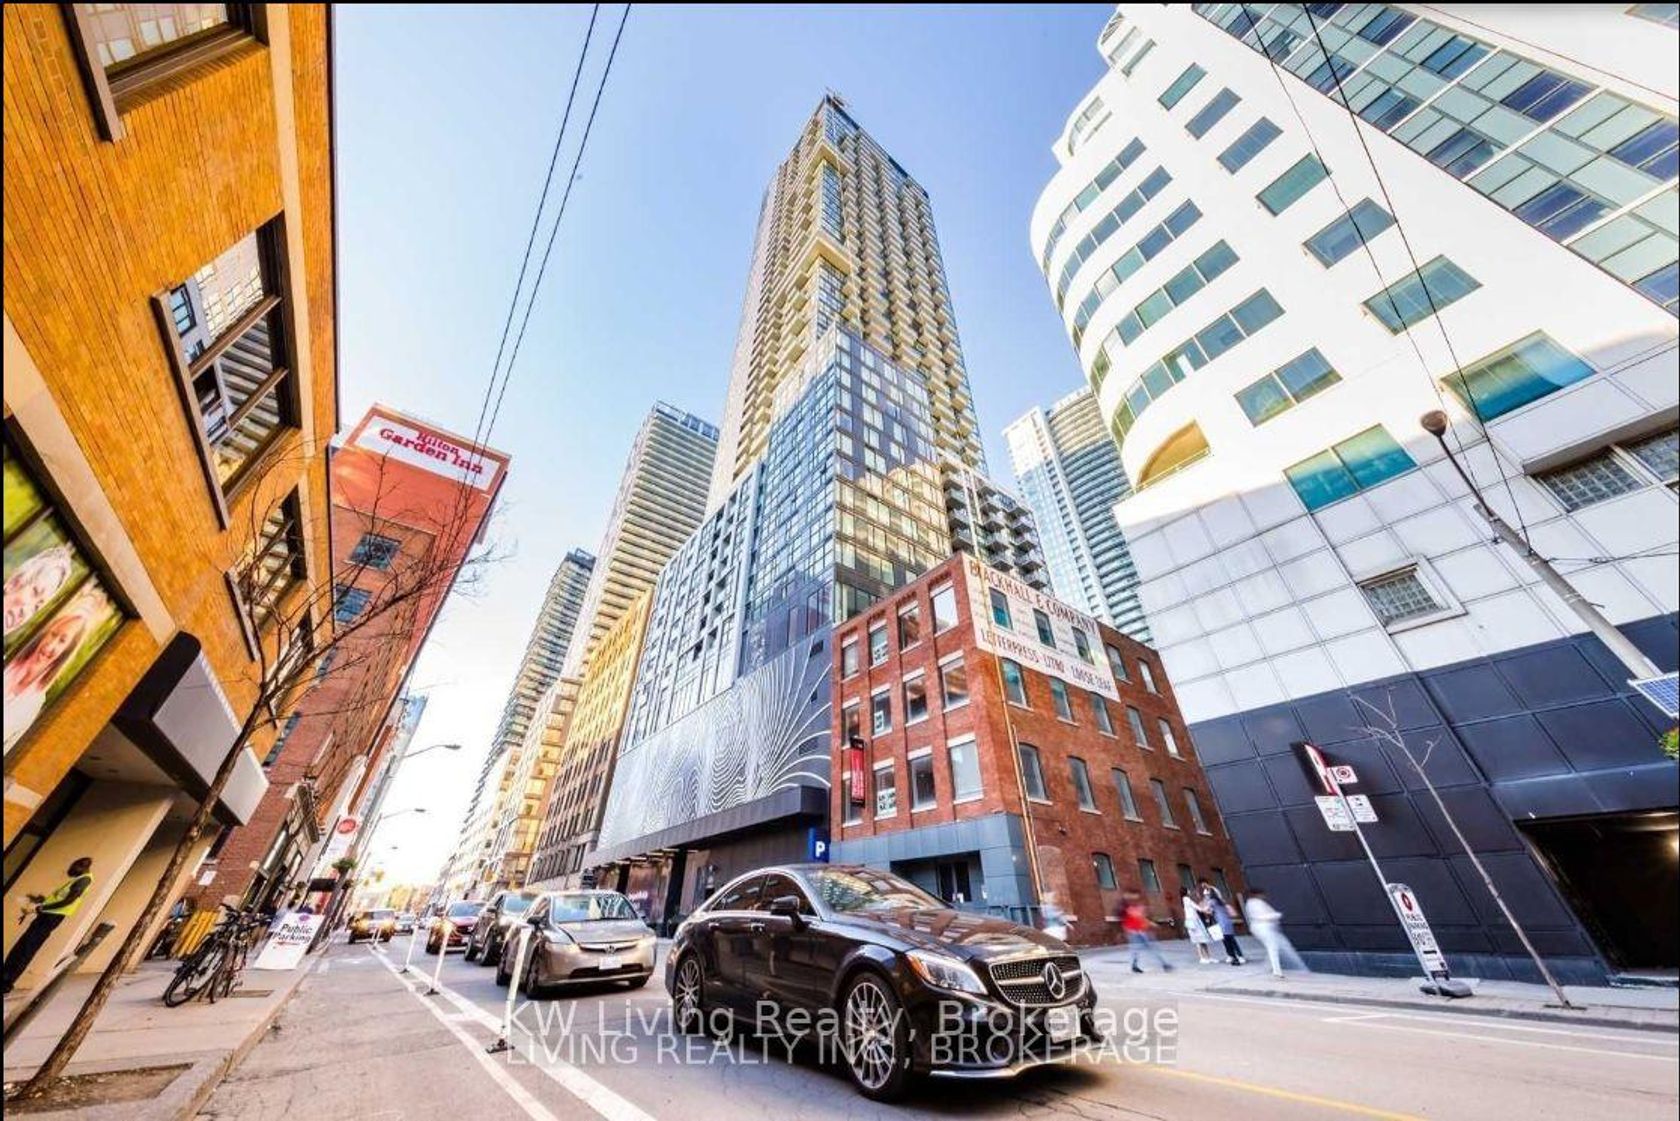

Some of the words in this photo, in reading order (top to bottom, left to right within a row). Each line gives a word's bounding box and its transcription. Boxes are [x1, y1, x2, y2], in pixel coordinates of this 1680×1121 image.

[380, 428, 448, 461] Garden
[451, 455, 483, 474] Inn
[416, 431, 460, 456] Hilton
[1046, 600, 1097, 635] COMPANY
[815, 841, 826, 857] P
[273, 932, 312, 943] Parking
[280, 923, 313, 934] Public
